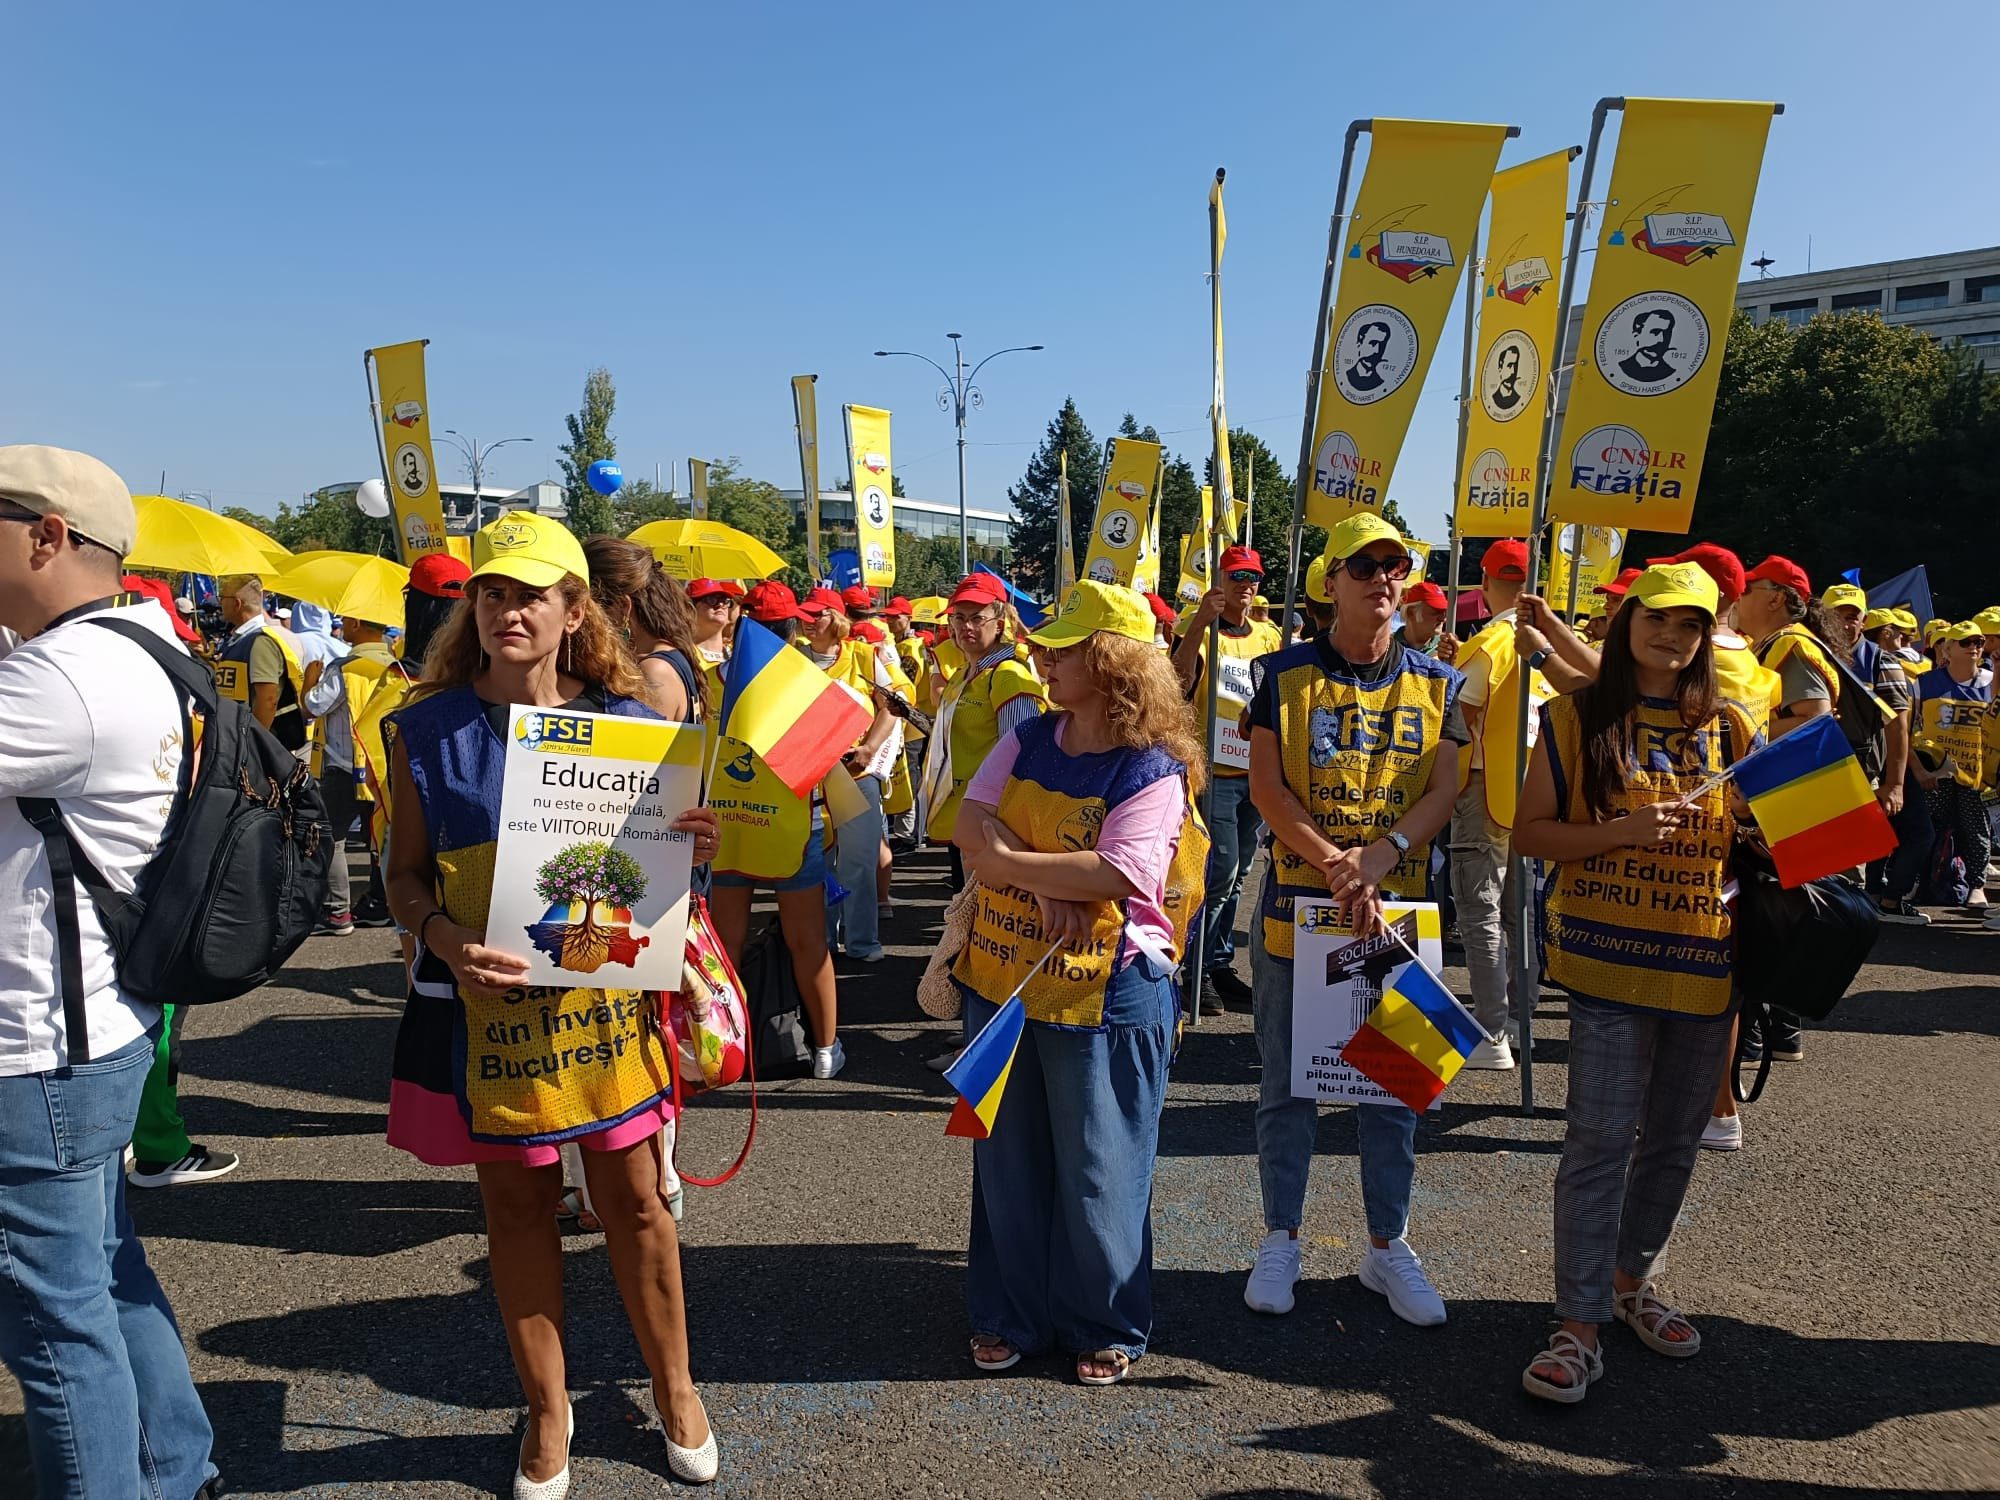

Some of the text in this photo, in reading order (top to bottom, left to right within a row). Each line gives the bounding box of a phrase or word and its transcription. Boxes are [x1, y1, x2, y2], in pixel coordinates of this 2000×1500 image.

[1666, 227, 1718, 236] HUNEDOARA
[1396, 245, 1441, 257] HUNEDOARA
[1607, 296, 1649, 330] SINDICATELOR
[1650, 295, 1699, 320] INDEPENDENTE
[1331, 452, 1382, 477] CNSLR
[1601, 446, 1686, 470] CNSLR
[1483, 467, 1531, 482] CNSLR
[216, 668, 235, 688] SE
[542, 716, 593, 741] FSE
[1340, 707, 1419, 751] FSE
[542, 742, 564, 752] Spiru
[542, 761, 660, 799] Educația
[533, 798, 667, 819] nu este o cheltuială,
[508, 818, 687, 843] este VIITORUL României!
[1584, 856, 1618, 876] din
[1338, 922, 1407, 965] SOCIETATE
[1591, 935, 1660, 957] SUNTEM
[485, 1021, 531, 1045] din
[1306, 1069, 1351, 1082] pilonul
[1317, 1083, 1343, 1094] Nu-l
